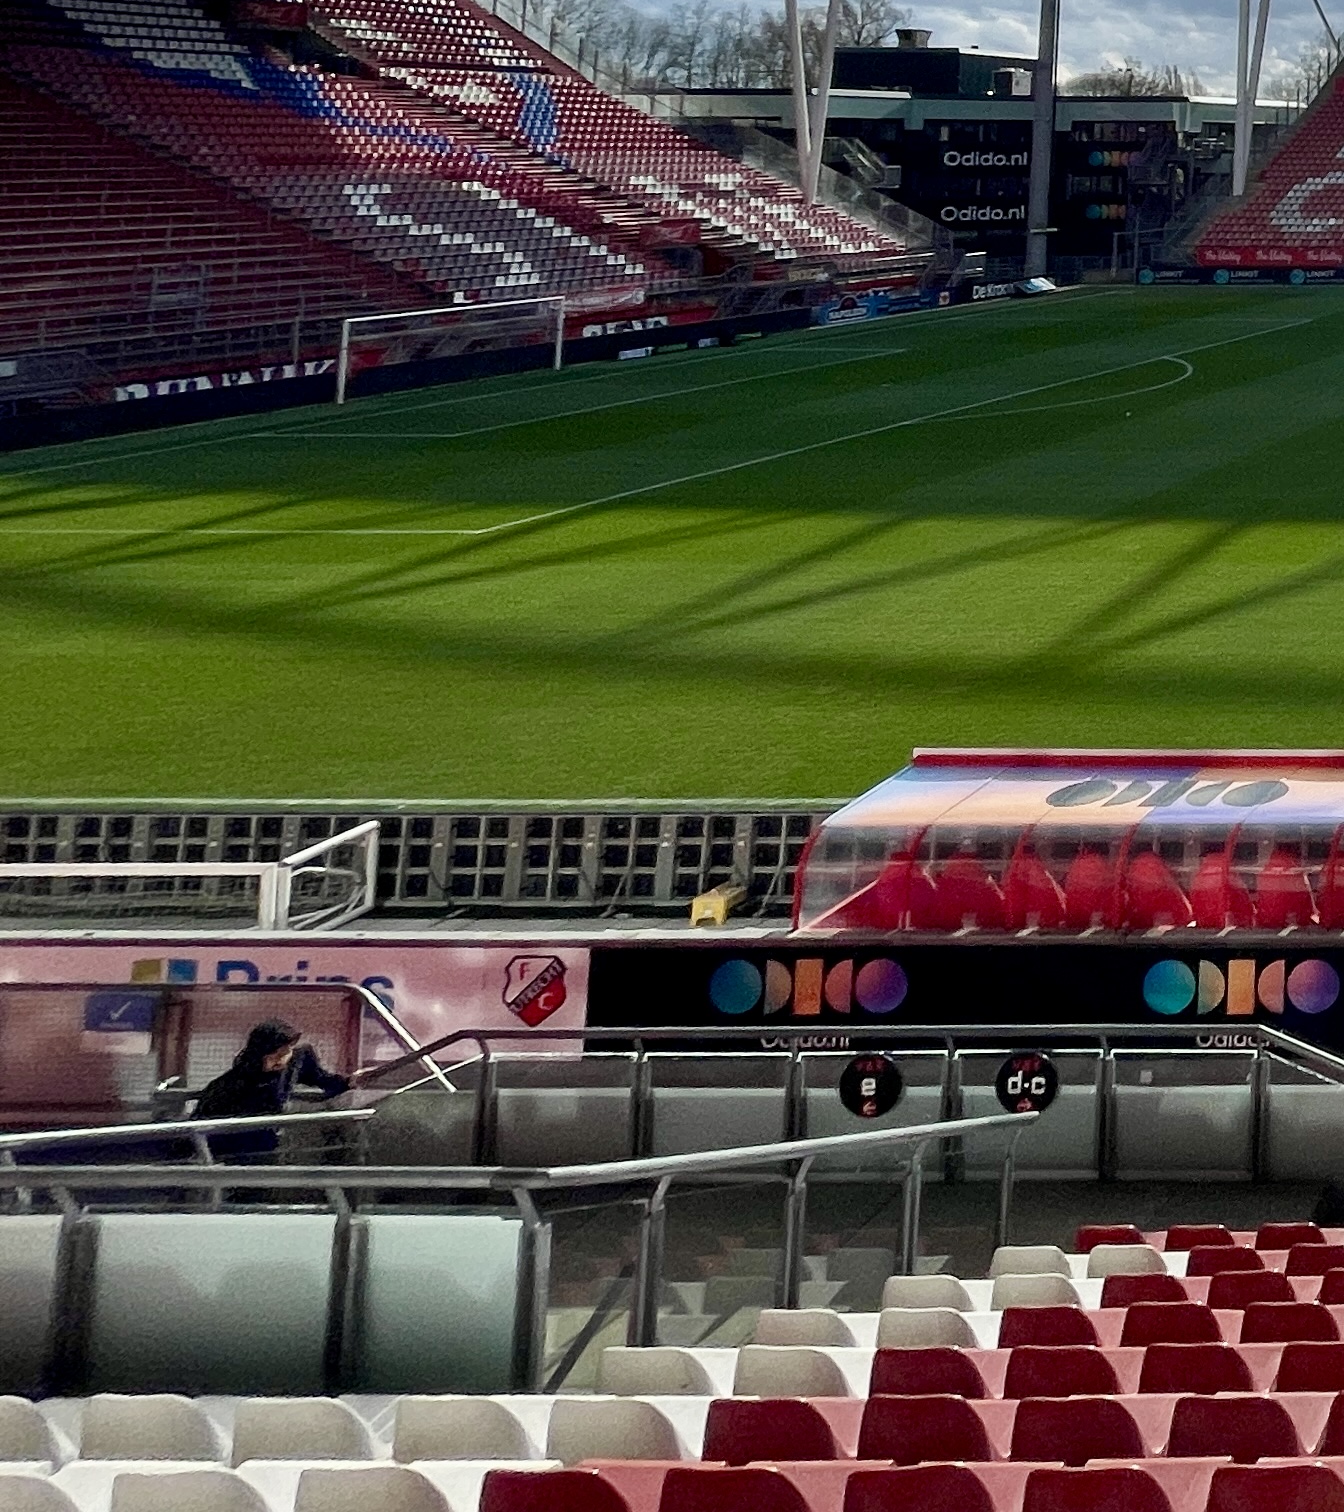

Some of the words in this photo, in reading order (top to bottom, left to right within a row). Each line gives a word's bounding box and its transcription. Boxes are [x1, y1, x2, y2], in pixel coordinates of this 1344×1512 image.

[943, 151, 1028, 166] Odido.nl
[941, 205, 1025, 221] Odido.nl
[519, 962, 532, 981] F
[538, 992, 554, 1010] C
